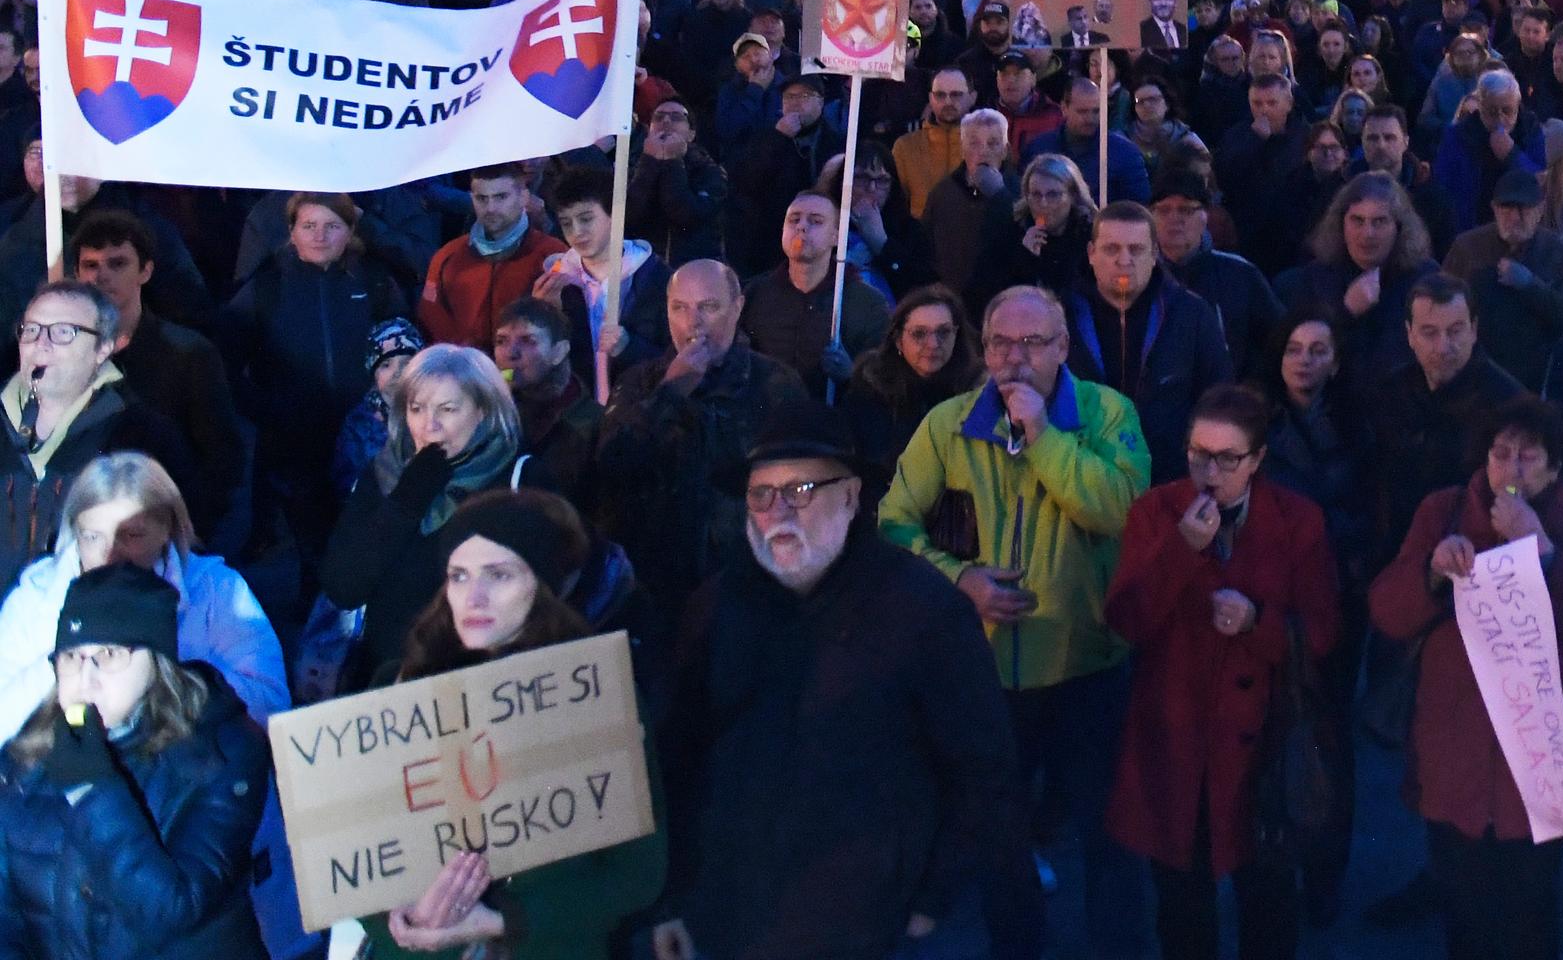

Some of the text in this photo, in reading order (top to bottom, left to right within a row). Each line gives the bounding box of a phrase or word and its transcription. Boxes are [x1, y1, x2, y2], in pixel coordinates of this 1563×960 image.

[222, 35, 503, 90] ŠTUDENTOV
[229, 82, 485, 130] SI NEDÁME
[290, 662, 601, 766] VYBRALI SME SI
[402, 731, 500, 813] EÚ
[330, 839, 406, 894] NIE
